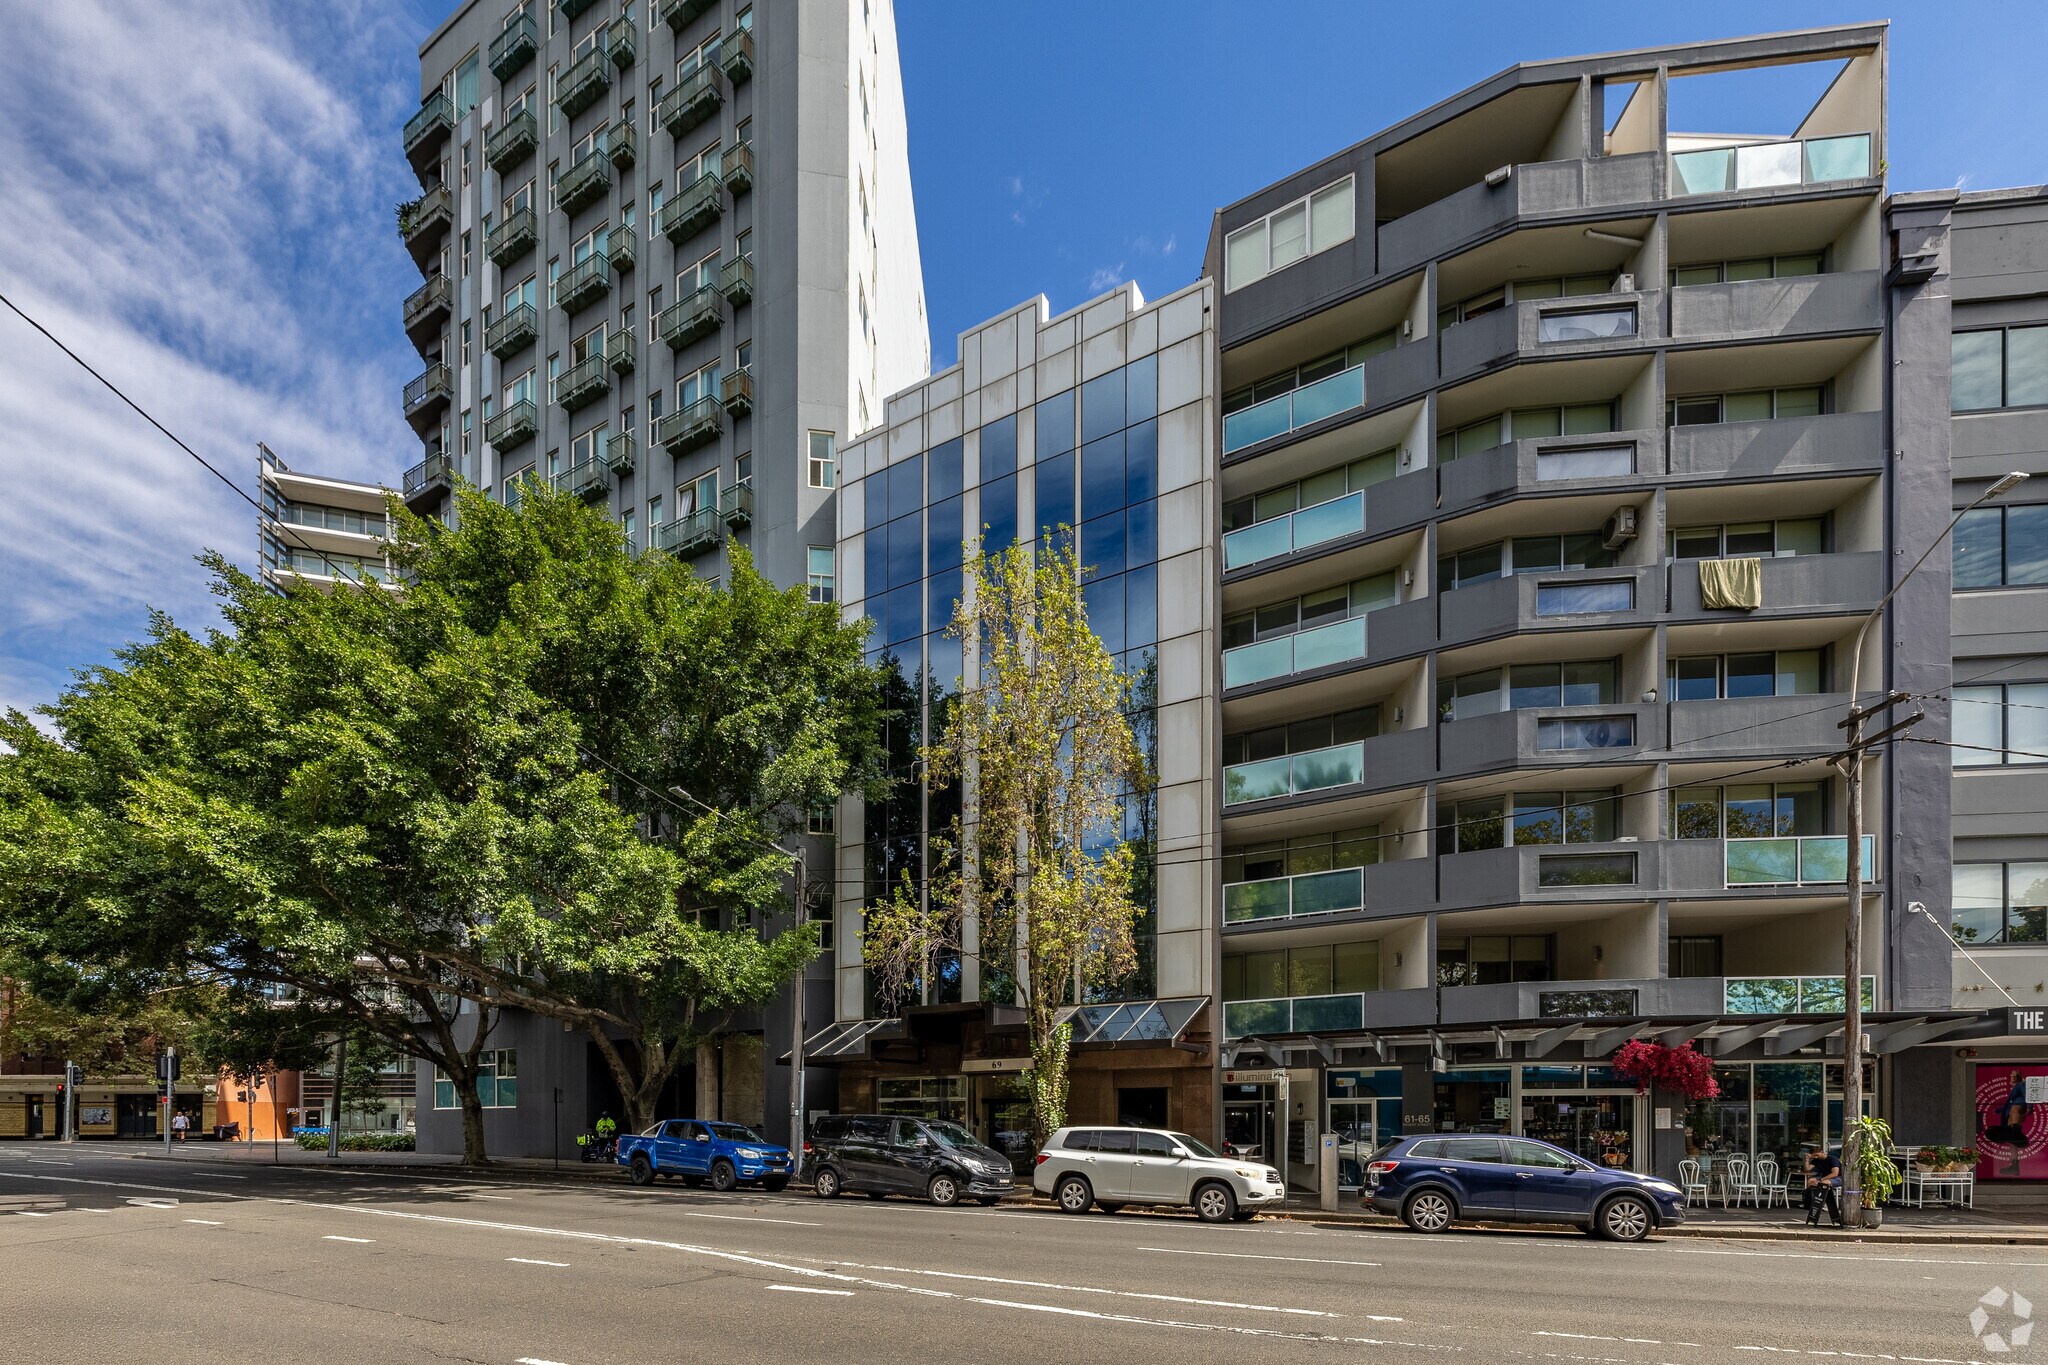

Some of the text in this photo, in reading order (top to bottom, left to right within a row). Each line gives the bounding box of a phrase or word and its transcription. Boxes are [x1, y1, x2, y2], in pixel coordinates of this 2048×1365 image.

[2013, 1011, 2044, 1030] THE
[992, 1061, 1002, 1069] 69
[1235, 1072, 1292, 1082] illuminan
[1404, 1114, 1431, 1123] 61-65
